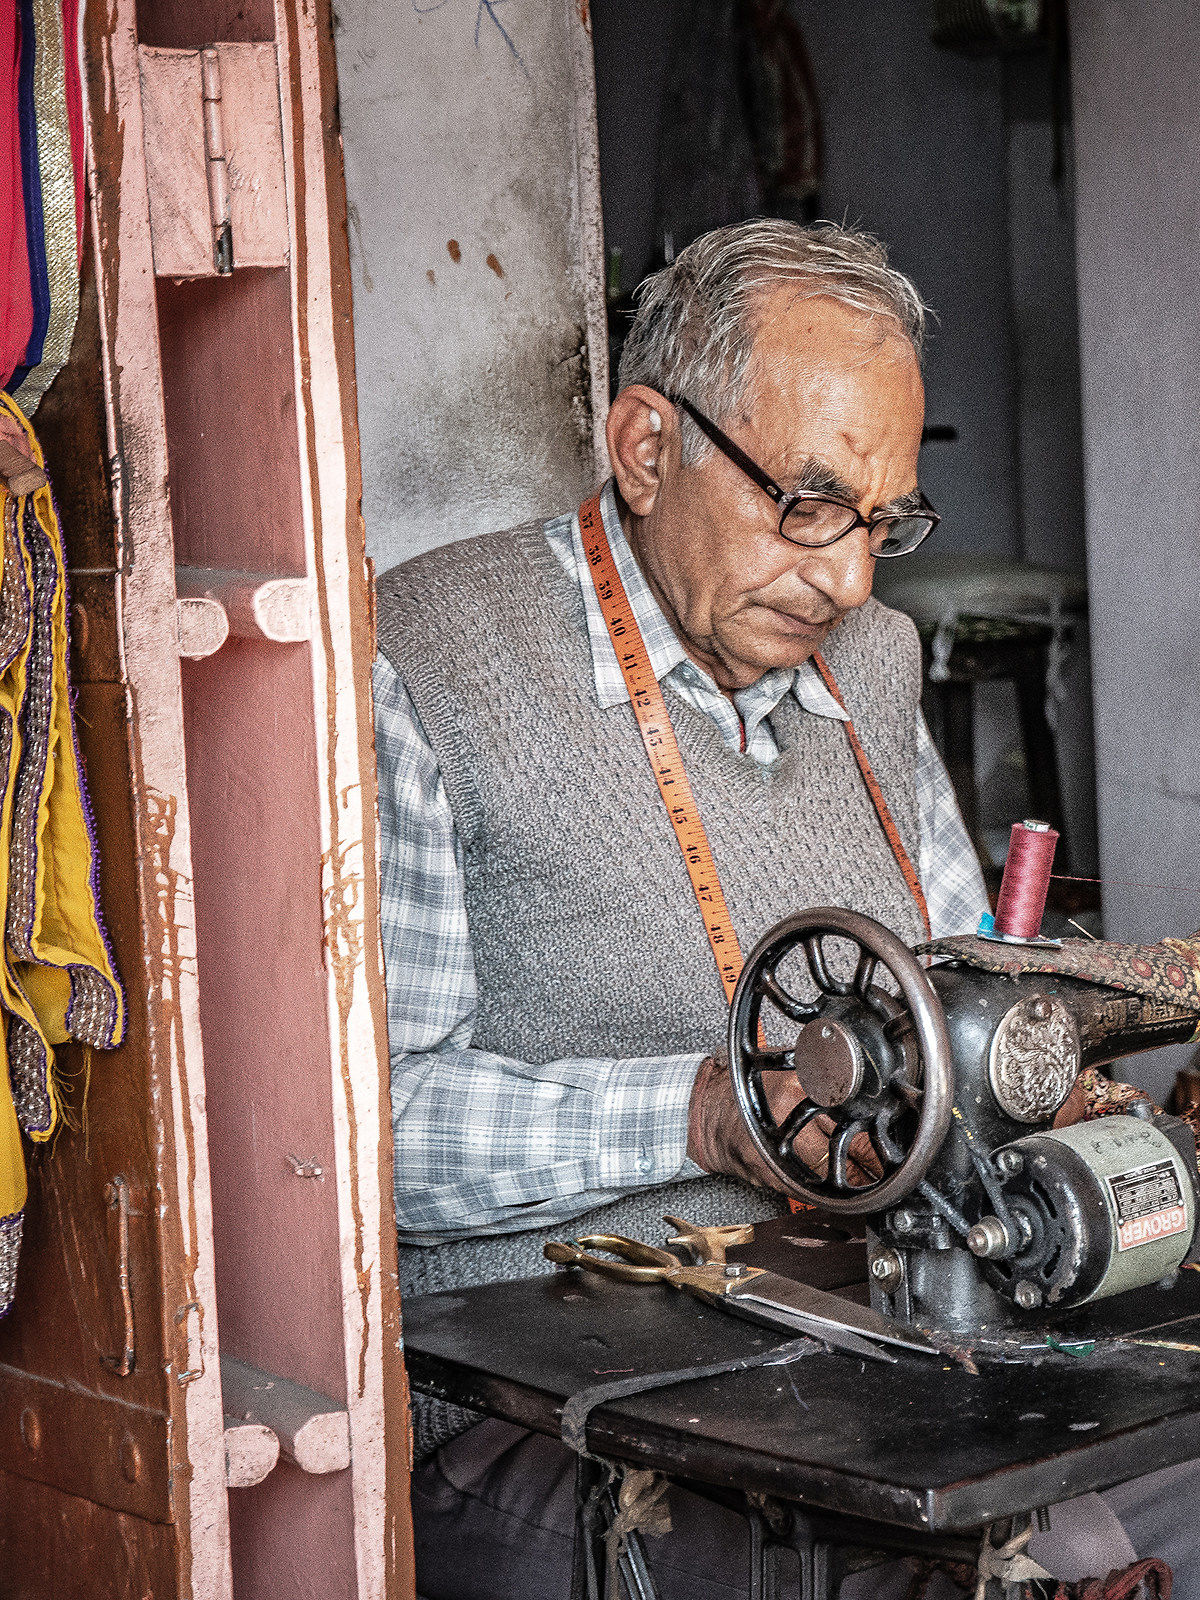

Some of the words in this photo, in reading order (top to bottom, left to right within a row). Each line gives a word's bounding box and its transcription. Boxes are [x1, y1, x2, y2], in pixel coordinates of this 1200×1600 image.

[582, 512, 593, 529] 37
[588, 545, 602, 566] 38
[599, 580, 613, 600] 39
[610, 617, 626, 637] 40
[621, 653, 638, 671] 41
[634, 688, 651, 708] 42
[647, 726, 662, 747] 43
[660, 766, 675, 786] 44
[672, 805, 688, 824] 45
[686, 844, 701, 864] 46
[699, 884, 713, 902] 47
[711, 924, 725, 944] 48
[723, 963, 737, 983] 49
[1122, 1209, 1184, 1244] GROVER
